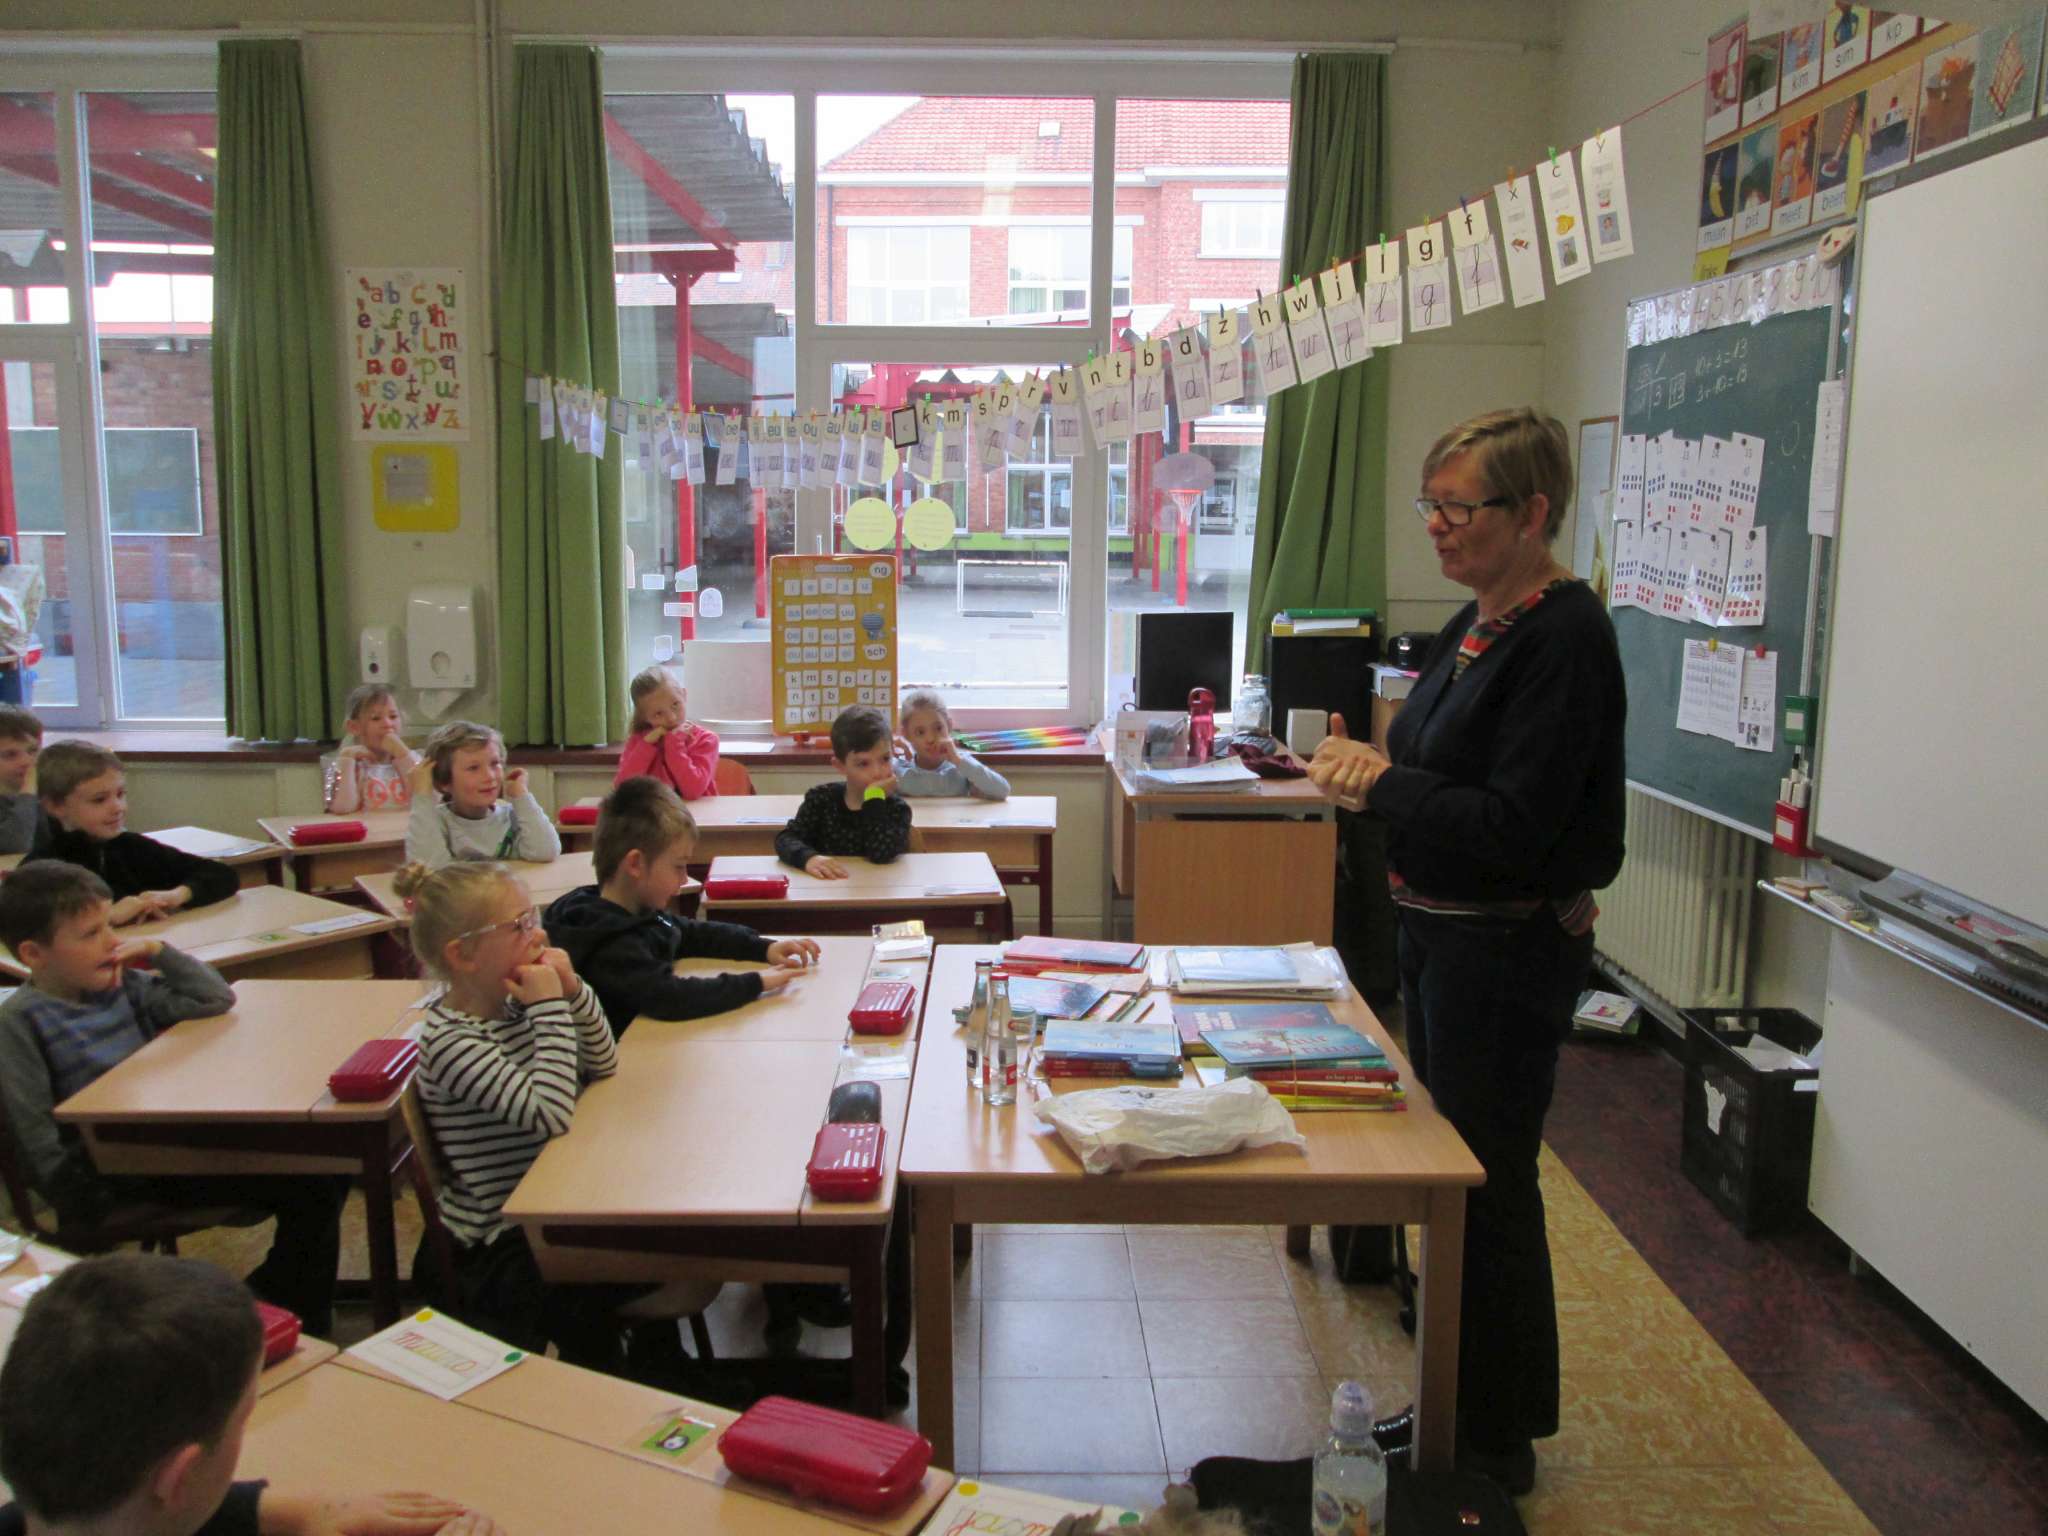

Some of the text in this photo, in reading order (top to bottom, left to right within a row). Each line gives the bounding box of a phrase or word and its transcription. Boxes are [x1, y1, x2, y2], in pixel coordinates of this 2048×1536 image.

[922, 408, 930, 425] k
[947, 409, 960, 420] m
[978, 403, 988, 416] s
[998, 394, 1009, 411] p
[1027, 386, 1037, 398] r
[1058, 381, 1068, 396] v
[1090, 370, 1101, 386] n
[1115, 361, 1122, 377] t
[1143, 349, 1154, 367] b
[1179, 336, 1192, 356] d
[1218, 319, 1229, 335] z
[1258, 307, 1272, 326] h
[1293, 293, 1308, 313] w
[1335, 275, 1342, 301] j
[1419, 239, 1433, 261] g
[1464, 214, 1473, 236] f
[1508, 187, 1519, 201] x
[1421, 284, 1436, 326] g
[440, 332, 457, 350] m
[382, 381, 397, 400] s
[435, 381, 450, 398] u
[874, 566, 888, 576] ng
[867, 647, 886, 657] sch
[844, 675, 852, 684] p
